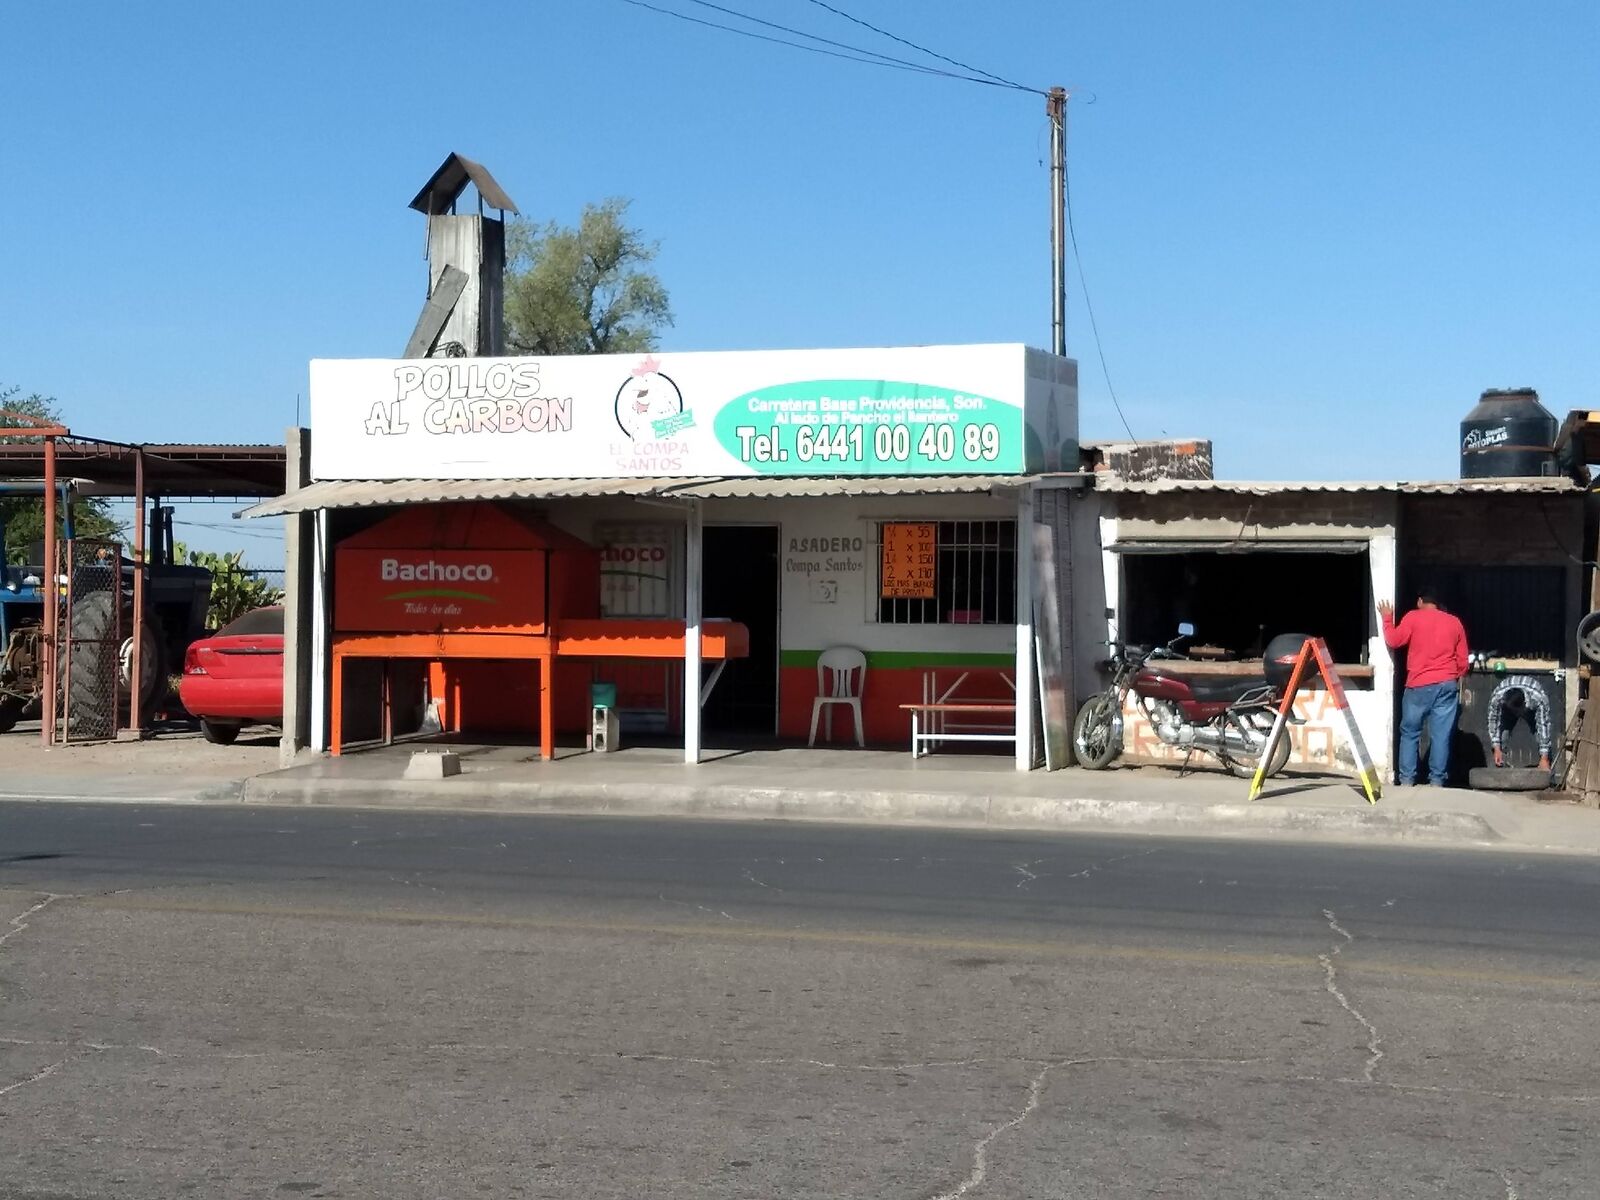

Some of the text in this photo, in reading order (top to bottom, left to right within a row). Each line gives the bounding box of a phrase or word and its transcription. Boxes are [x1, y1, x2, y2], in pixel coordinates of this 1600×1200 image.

[394, 363, 541, 401] POLLOS
[748, 397, 817, 412] Carretera
[819, 396, 857, 412] Base
[953, 394, 988, 410] Son.
[364, 398, 573, 435] AL CARBON
[633, 442, 690, 456] COMPA
[736, 422, 1001, 462] Tel. 6441 00 40 89
[616, 457, 683, 471] SANTOS
[789, 537, 863, 552] ASADERO
[888, 540, 895, 551] 1
[381, 558, 494, 582] Bachoco
[786, 556, 864, 577] Compa Santos
[887, 565, 896, 579] 2
[403, 602, 428, 614] Todos
